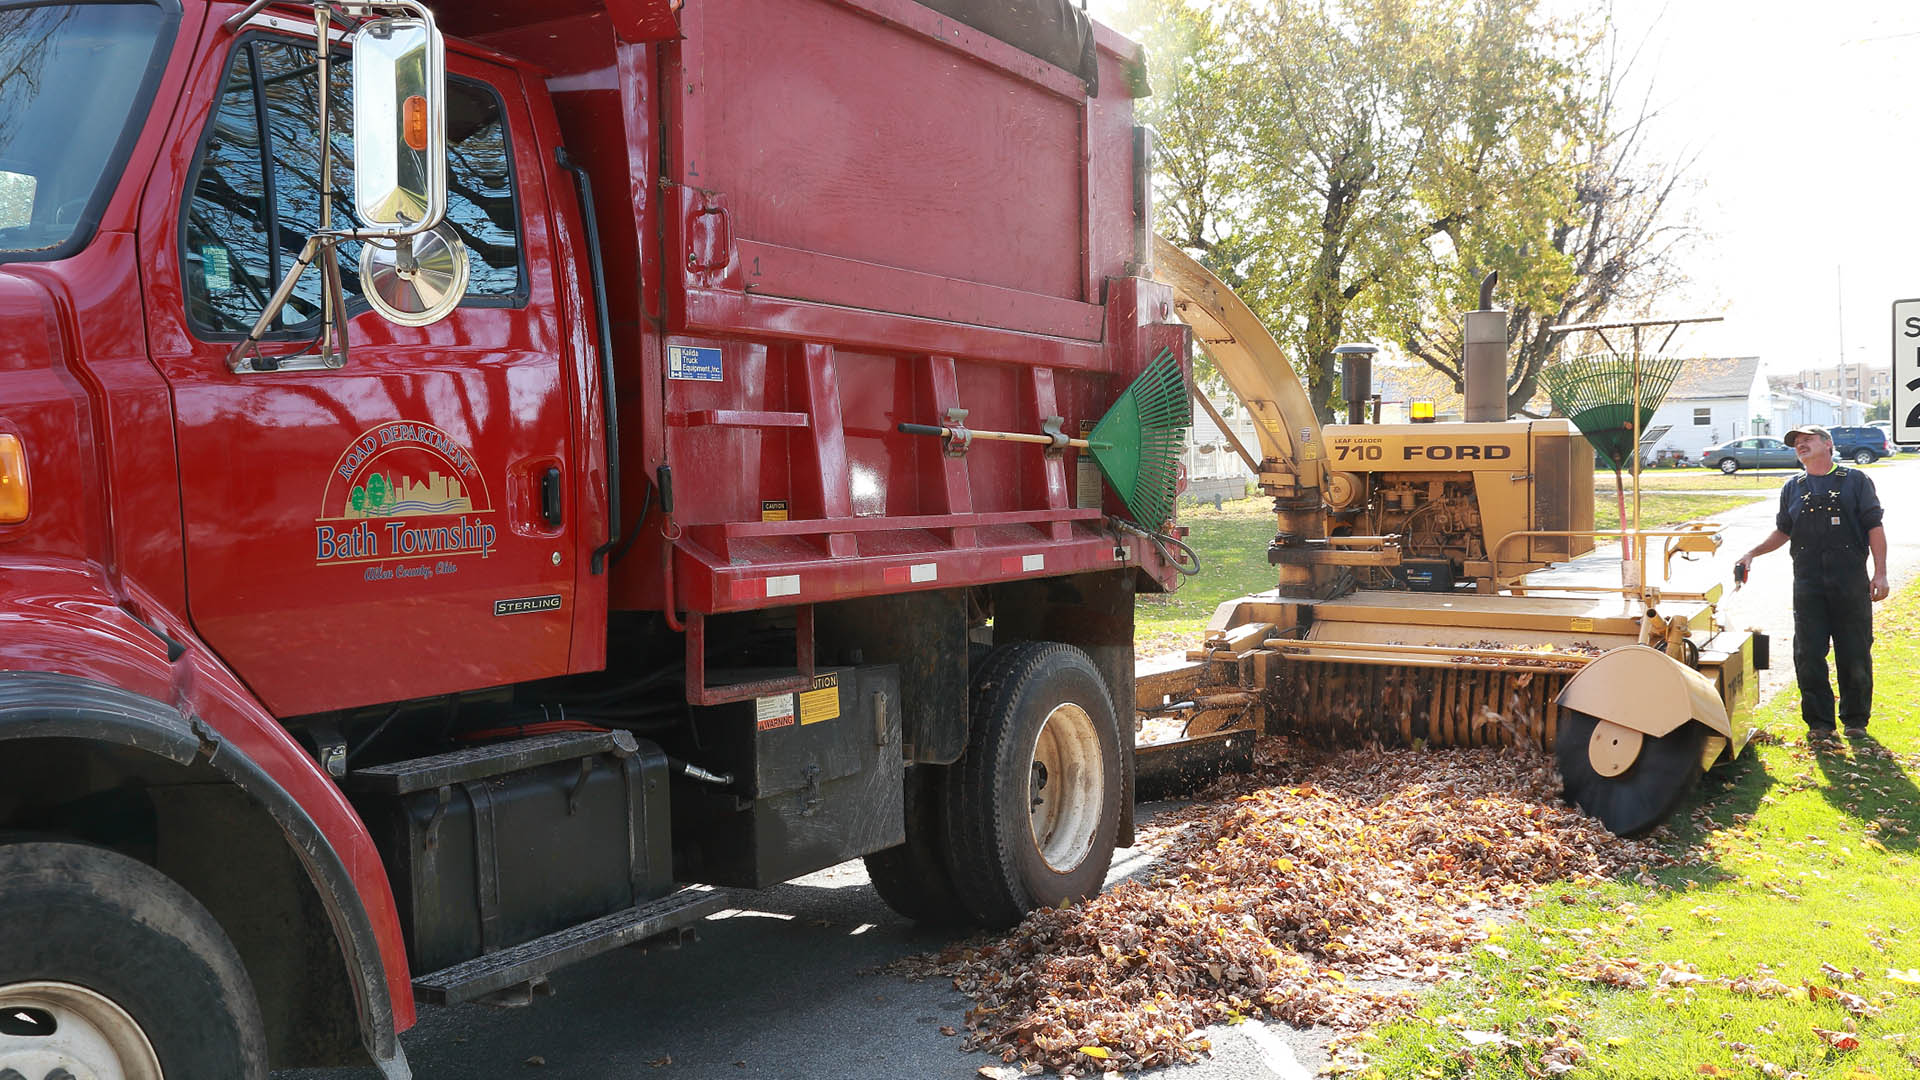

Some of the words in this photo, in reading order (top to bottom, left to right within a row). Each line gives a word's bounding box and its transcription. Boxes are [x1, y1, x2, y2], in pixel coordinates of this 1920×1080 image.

[682, 355, 699, 364] Truck
[338, 436, 377, 480] ROAD
[379, 424, 474, 476] DEPARTMENT
[1335, 445, 1383, 461] 710
[1403, 445, 1511, 461] FORD
[315, 520, 378, 561] Bath
[384, 515, 497, 559] Township
[363, 564, 393, 582] Allen
[395, 562, 433, 579] County,
[435, 560, 457, 575] Ohio
[498, 598, 560, 612] STERLING
[765, 715, 794, 730] WARNING
